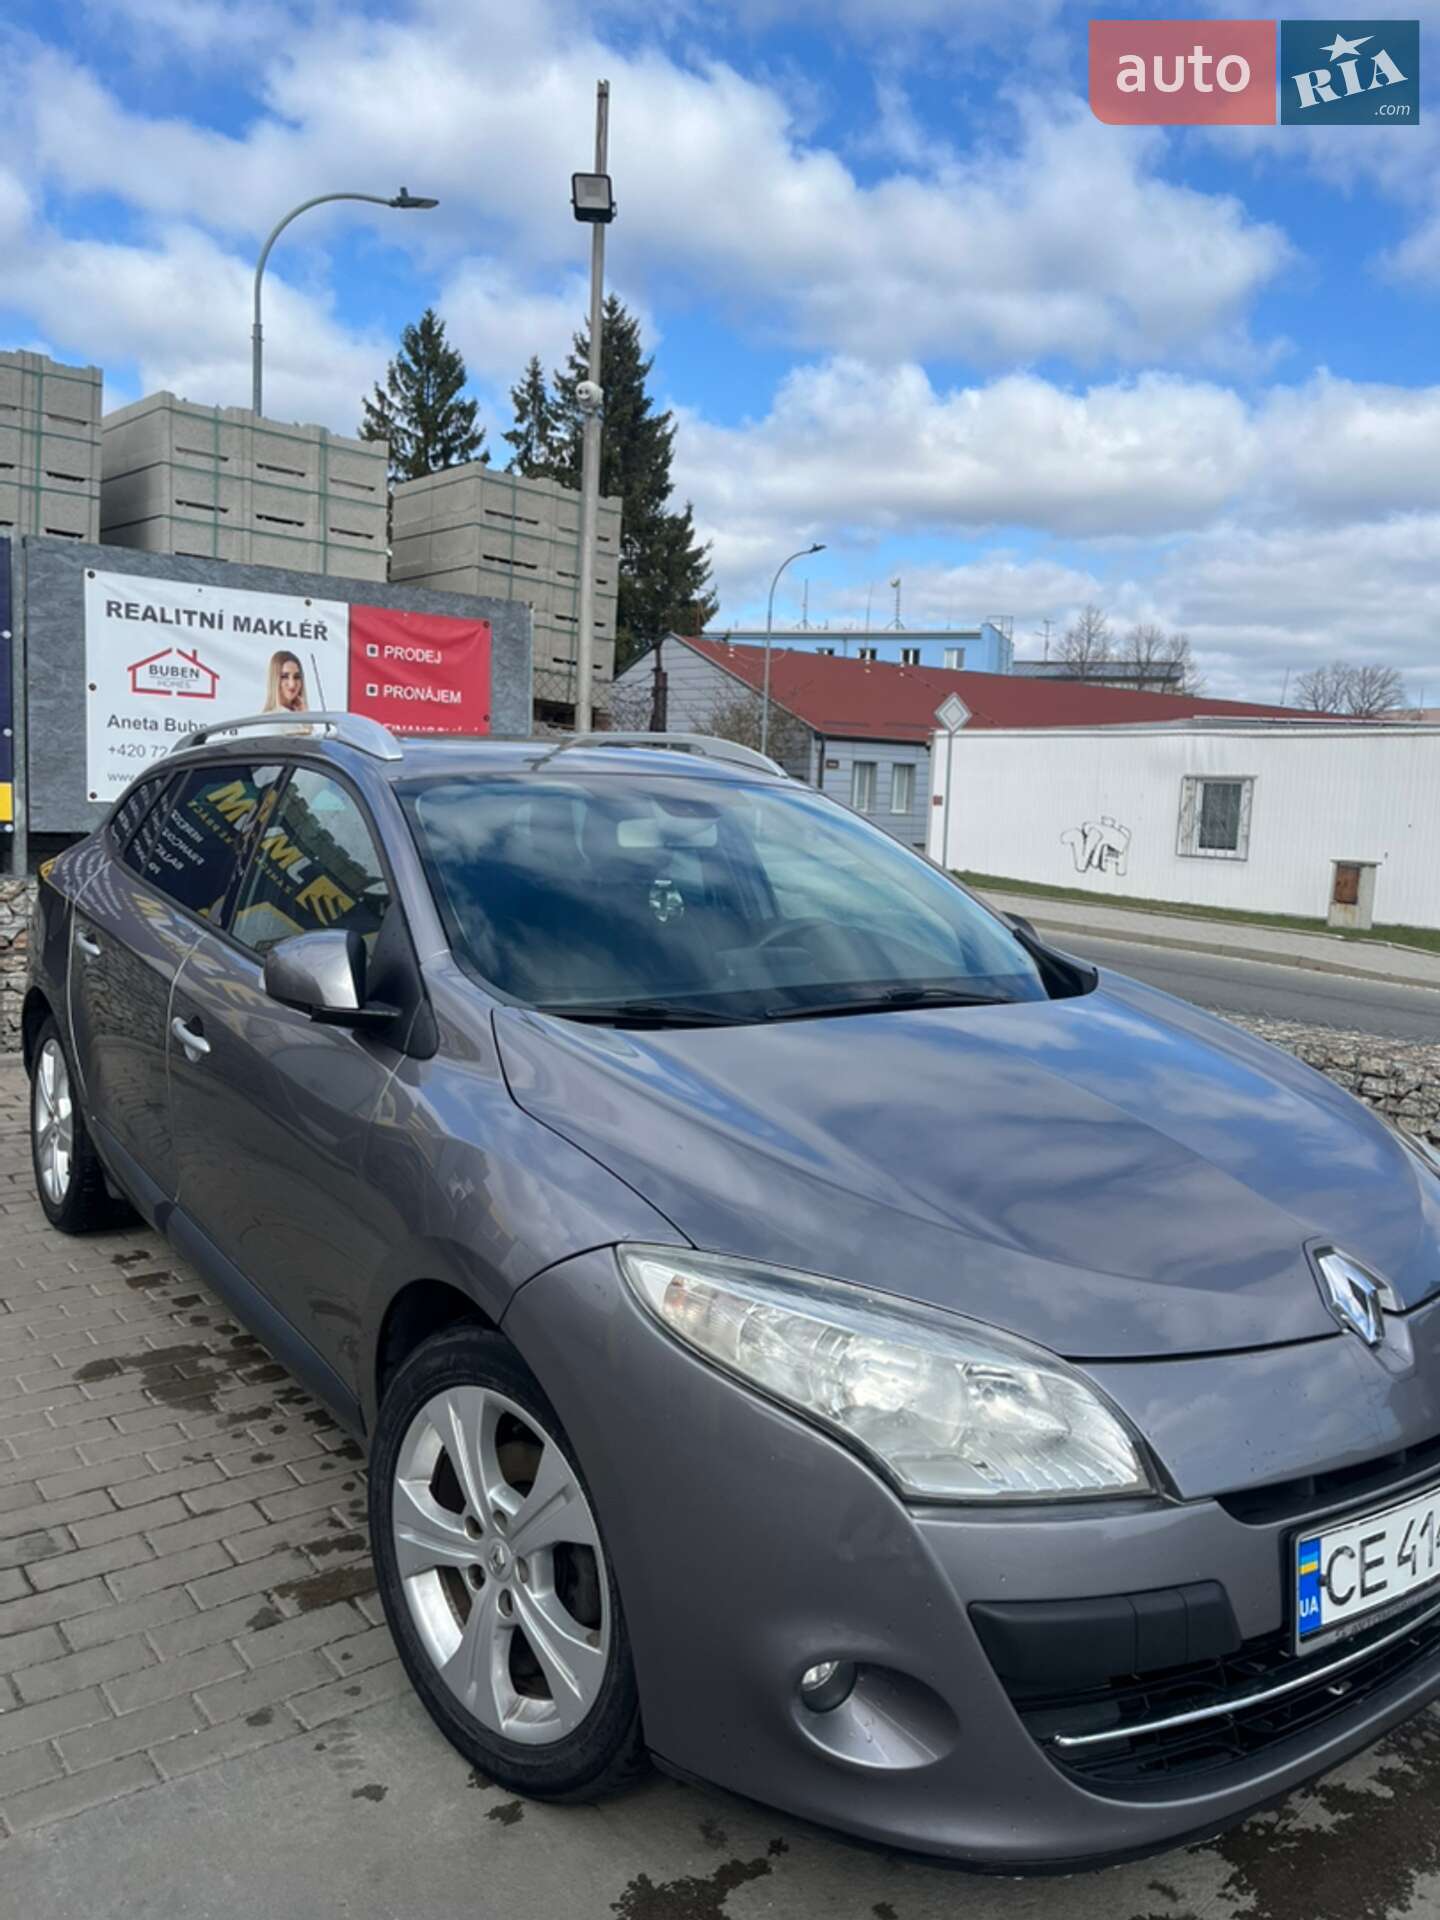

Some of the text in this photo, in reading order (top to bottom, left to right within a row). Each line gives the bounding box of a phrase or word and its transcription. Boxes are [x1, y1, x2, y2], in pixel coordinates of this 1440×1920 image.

[106, 600, 328, 641] REALITNÍ MAKLÉŘ
[384, 645, 442, 665] PRODEJ
[149, 664, 200, 679] BUBEN
[383, 684, 462, 704] PRONÁJEM
[107, 714, 159, 731] Aneta
[108, 744, 145, 758] +420
[1326, 1509, 1440, 1606] CE 41
[1300, 1596, 1319, 1617] UA
